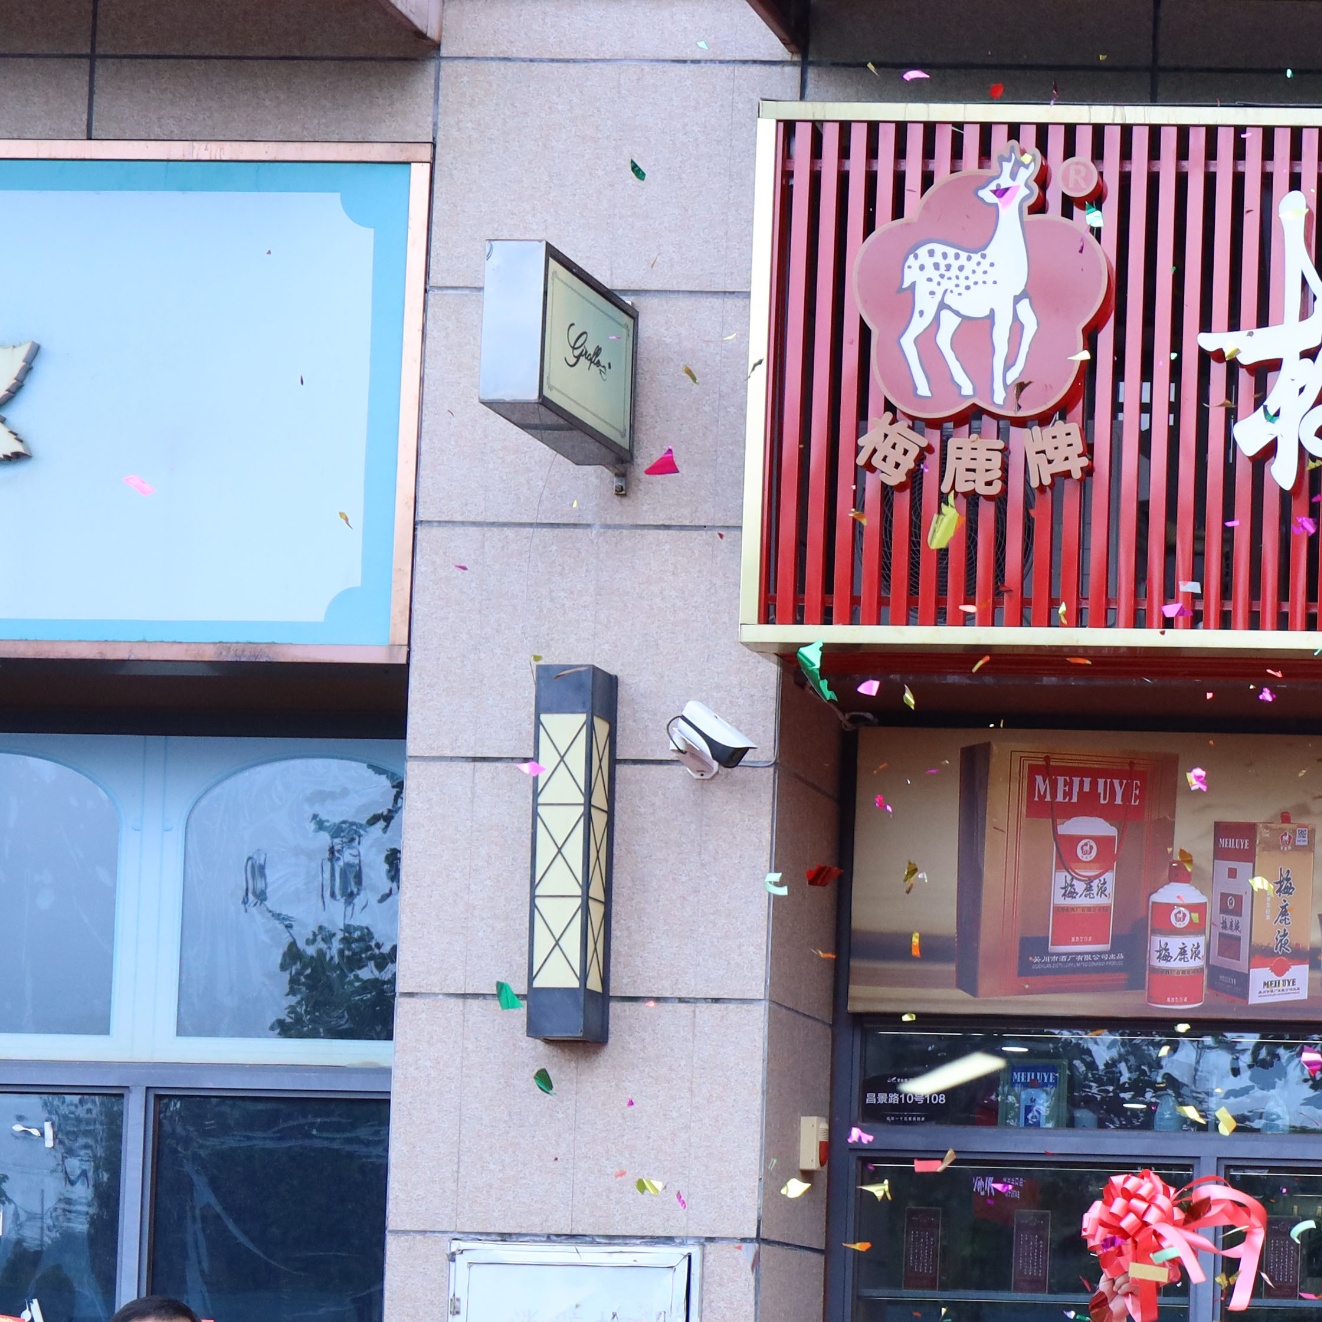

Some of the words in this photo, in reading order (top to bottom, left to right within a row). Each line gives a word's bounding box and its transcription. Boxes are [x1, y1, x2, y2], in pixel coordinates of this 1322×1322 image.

[856, 410, 1090, 497] 梅鹿牌
[1218, 837, 1250, 850] MEILUYE
[1060, 875, 1109, 900] 梅鹿液
[1274, 866, 1296, 955] 梅鹿液
[1155, 939, 1202, 964] 梅鹿液
[865, 1093, 946, 1105] 昌景路10号108
